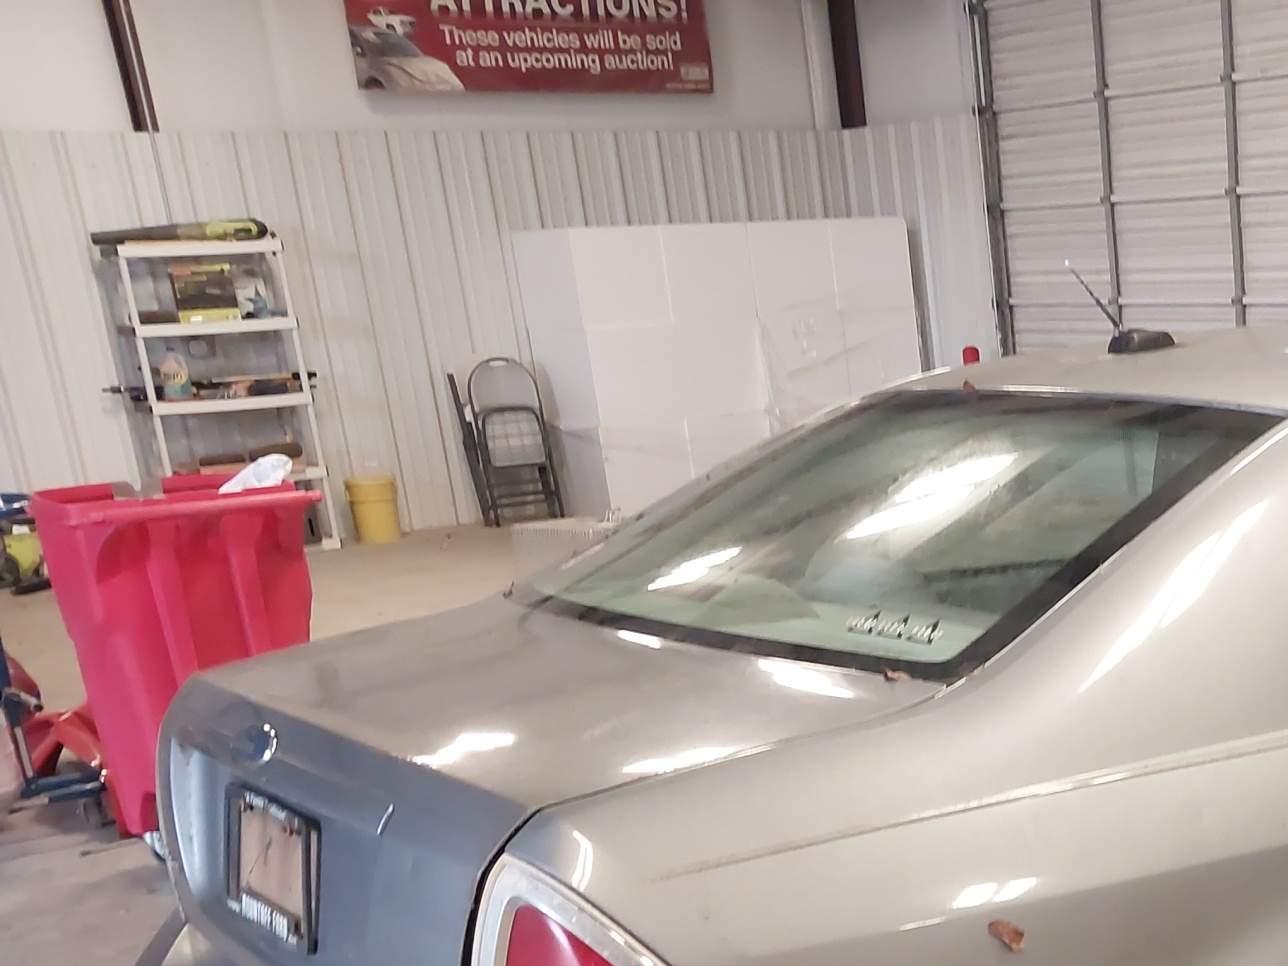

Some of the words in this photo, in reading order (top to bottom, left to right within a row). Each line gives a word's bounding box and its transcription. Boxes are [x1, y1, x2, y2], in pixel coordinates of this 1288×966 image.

[439, 24, 499, 47] These
[503, 27, 580, 49] vehicles
[584, 29, 614, 50] will
[618, 30, 641, 50] be
[646, 31, 681, 51] sold
[456, 48, 475, 67] at
[479, 50, 503, 68] an
[507, 50, 600, 75] upcoming
[604, 50, 673, 71] auction!
